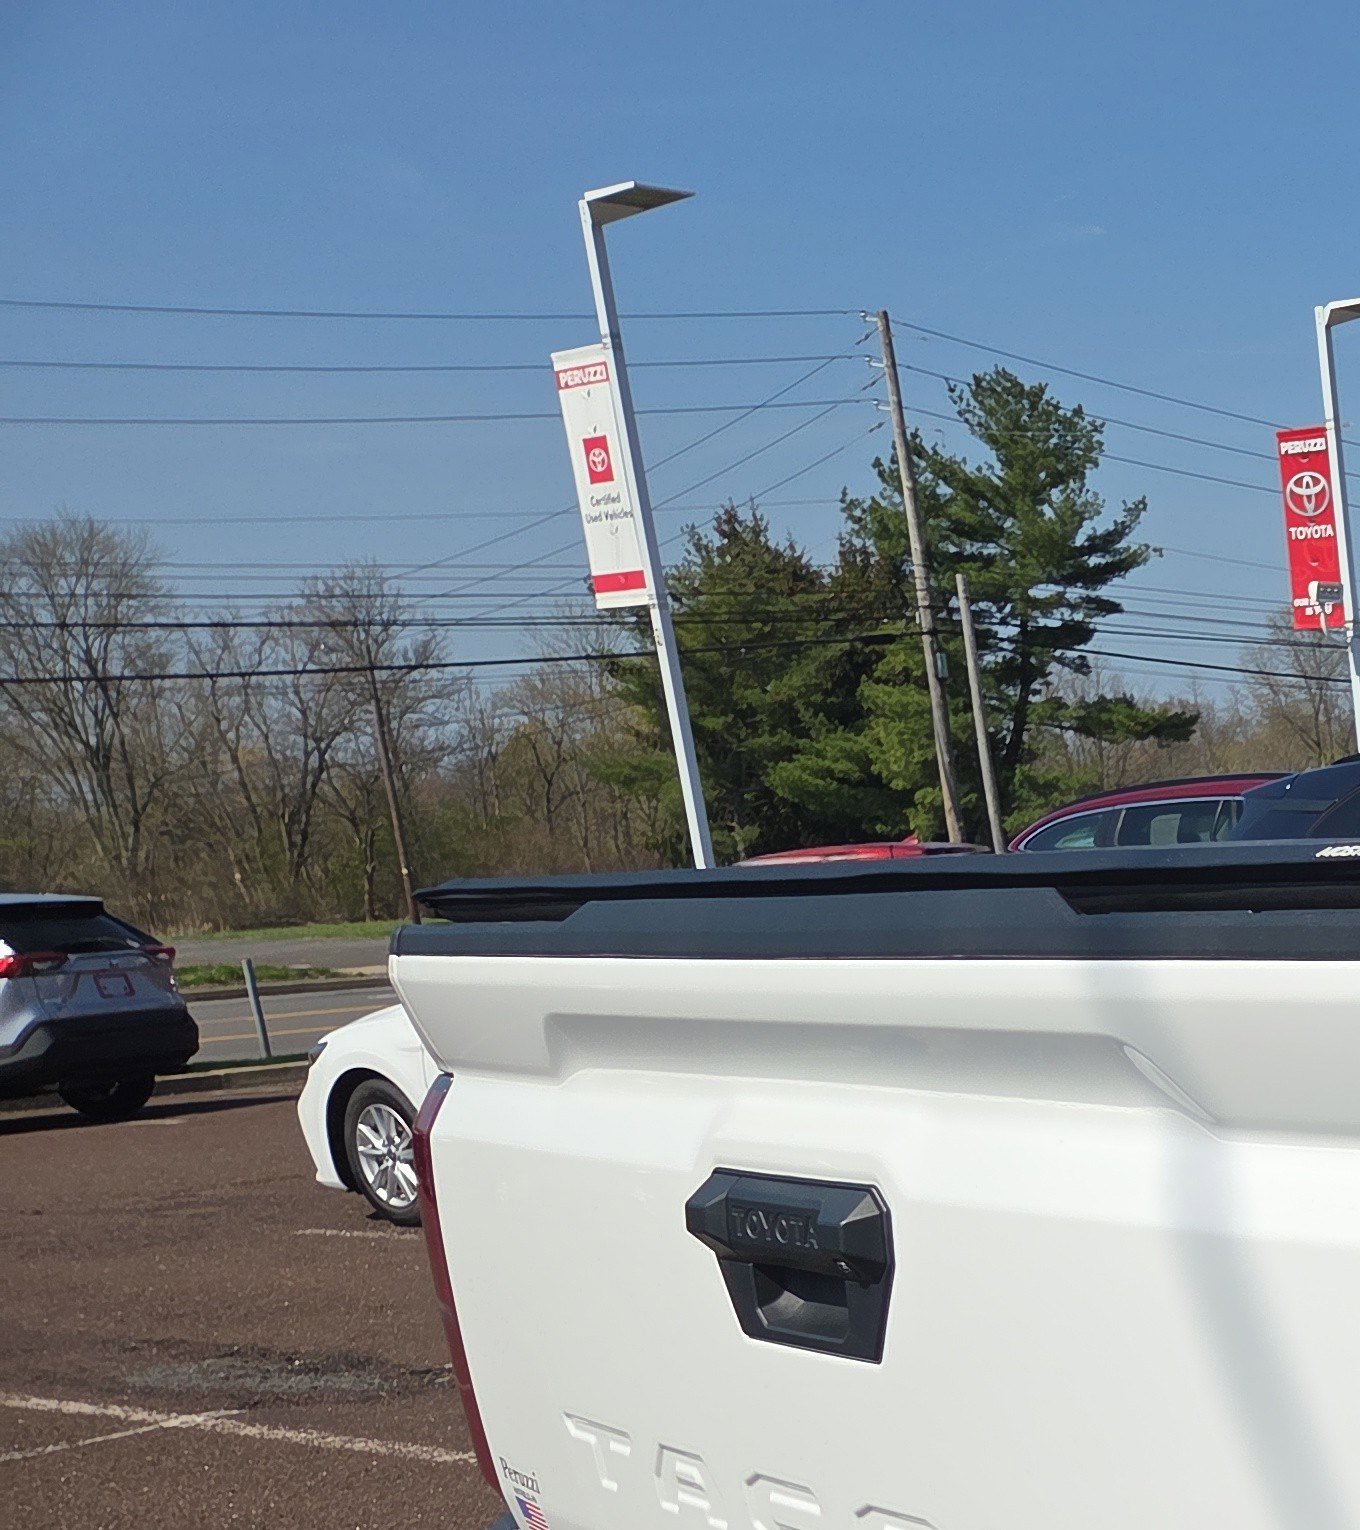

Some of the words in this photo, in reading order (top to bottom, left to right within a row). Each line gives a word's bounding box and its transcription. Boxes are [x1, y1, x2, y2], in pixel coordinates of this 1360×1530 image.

[559, 365, 607, 387] PERUZZI
[1280, 438, 1326, 454] PERUZZI
[1289, 523, 1334, 541] TOYOTA
[729, 1205, 820, 1251] TOYOTA
[499, 1456, 541, 1495] Peruzzi
